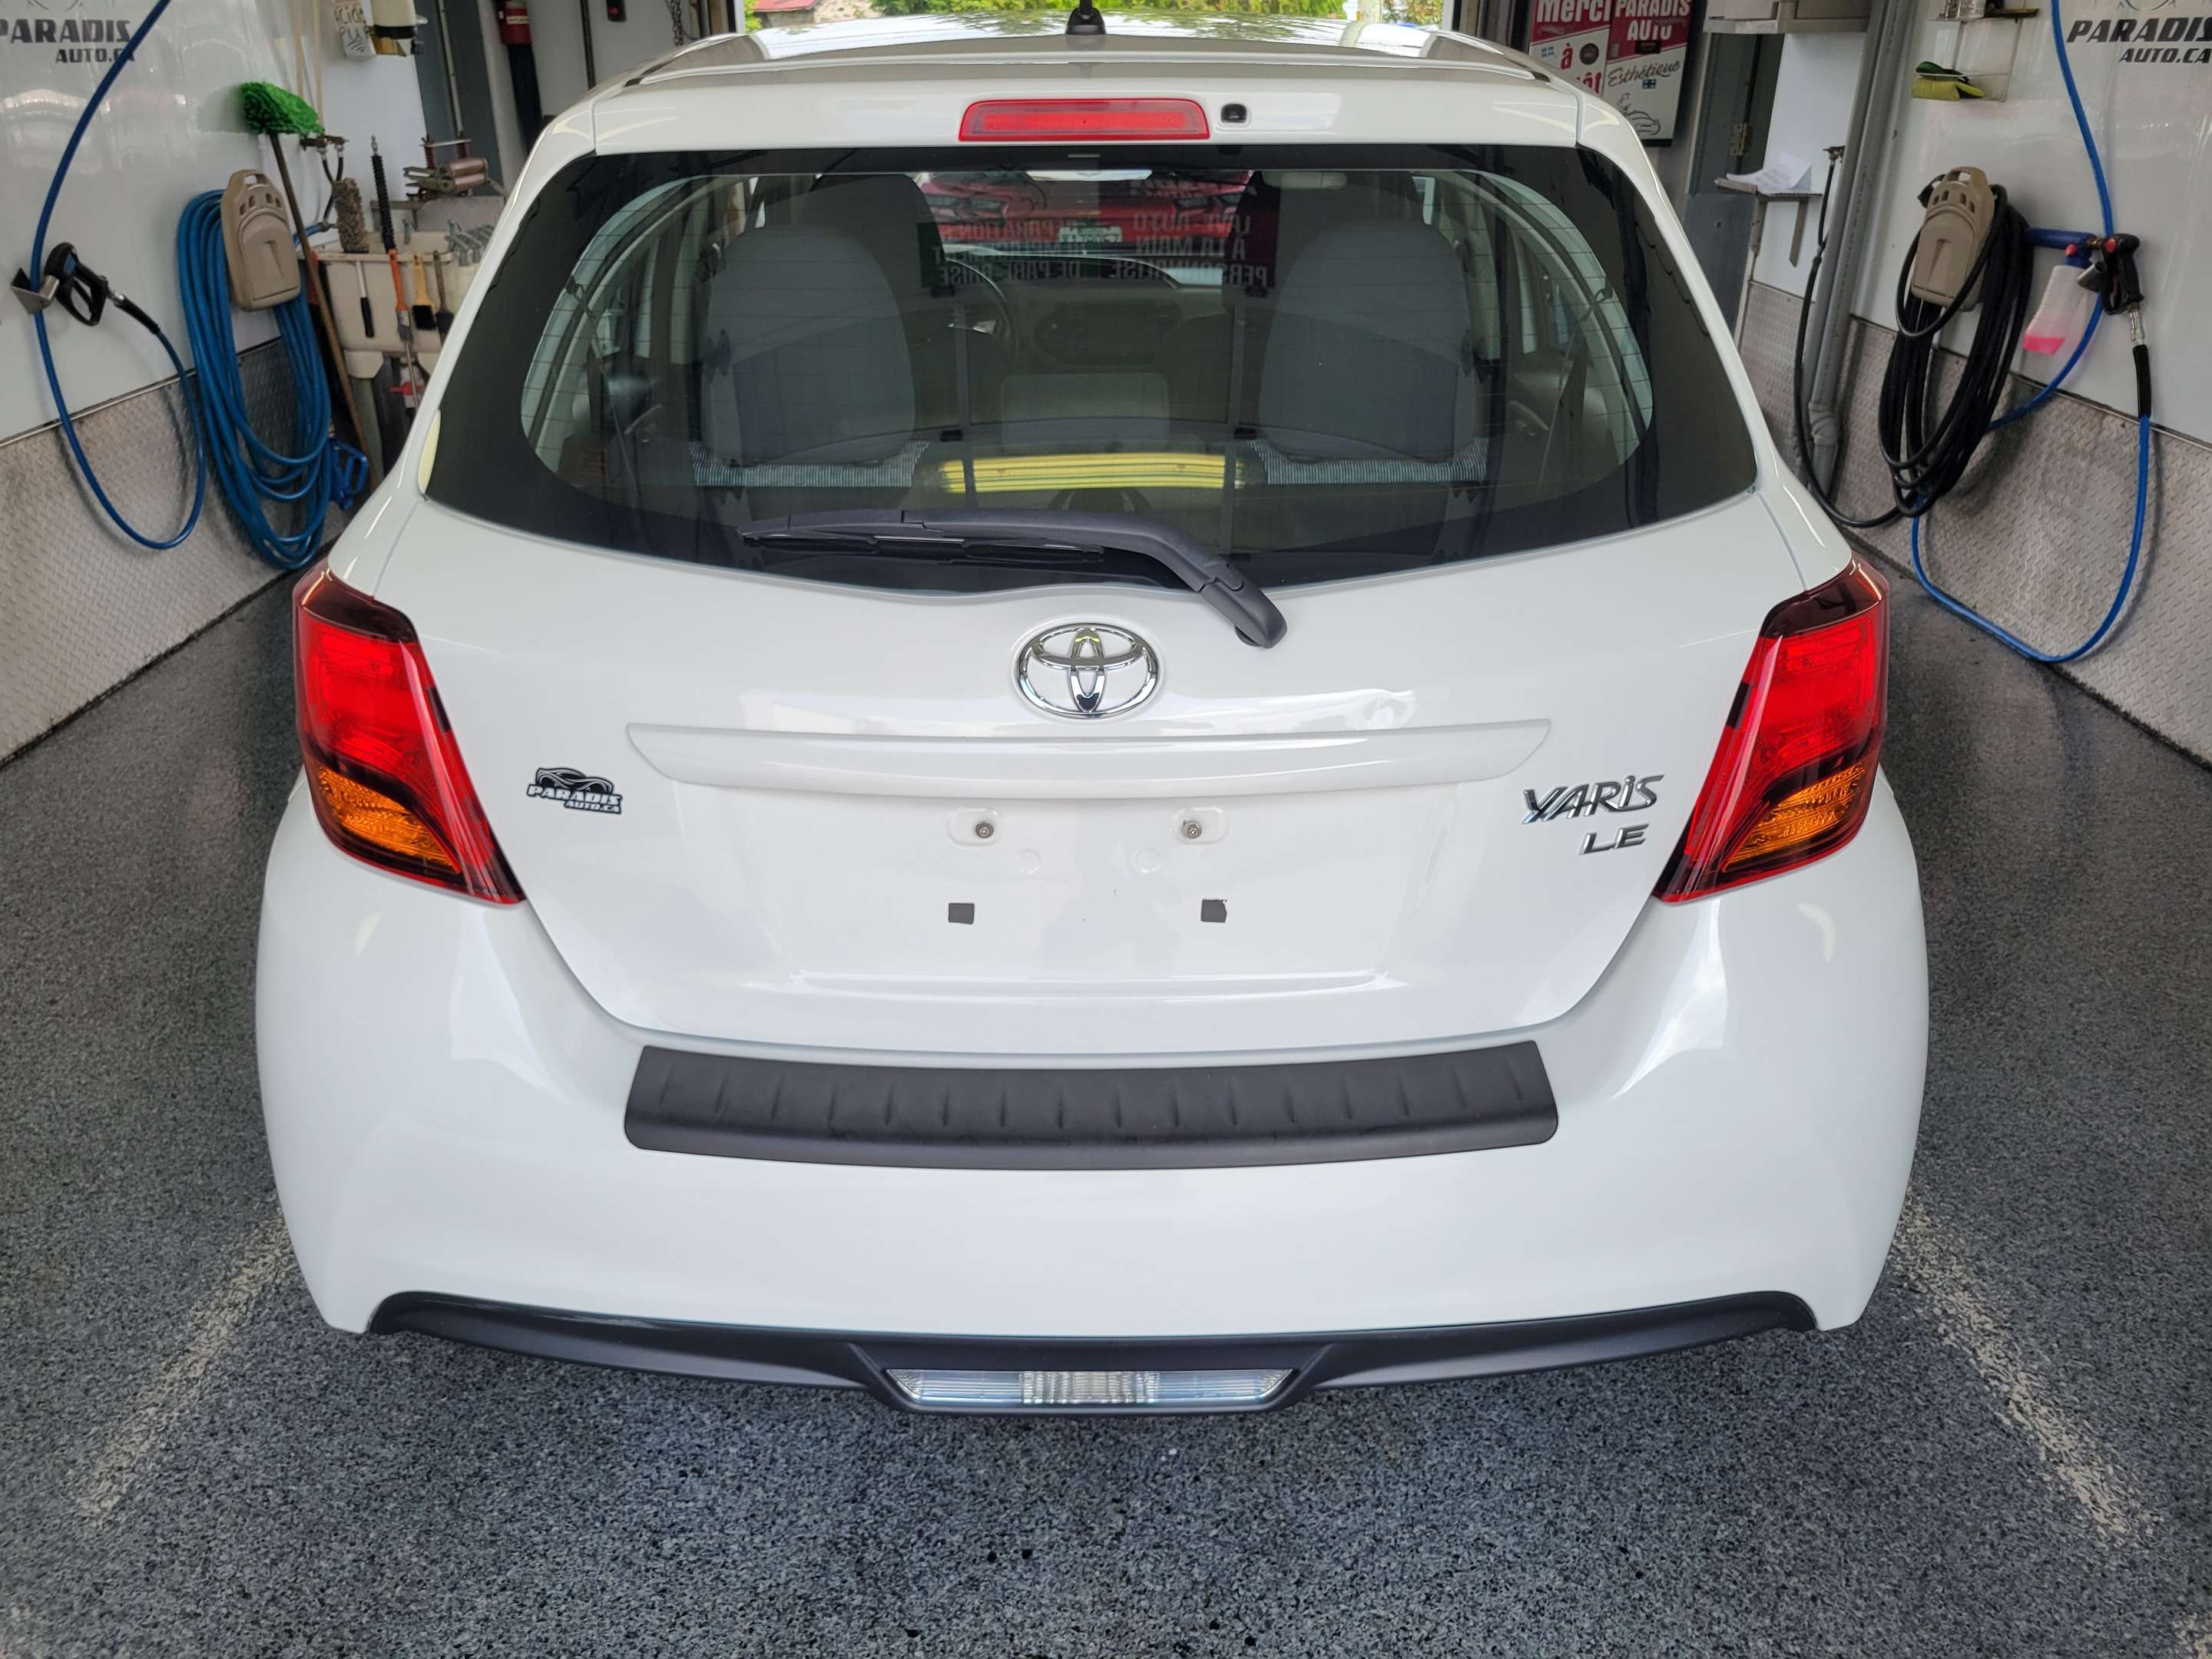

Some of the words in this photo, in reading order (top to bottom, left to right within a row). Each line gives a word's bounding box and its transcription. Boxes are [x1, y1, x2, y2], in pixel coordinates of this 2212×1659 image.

[1614, 0, 1690, 18] PARADIS
[55, 48, 135, 63] AUTO.C
[2118, 48, 2212, 63] AUTO.CA
[527, 784, 622, 805] PARADIS
[565, 800, 621, 813] AUTO.CA
[1578, 823, 1650, 856] LE
